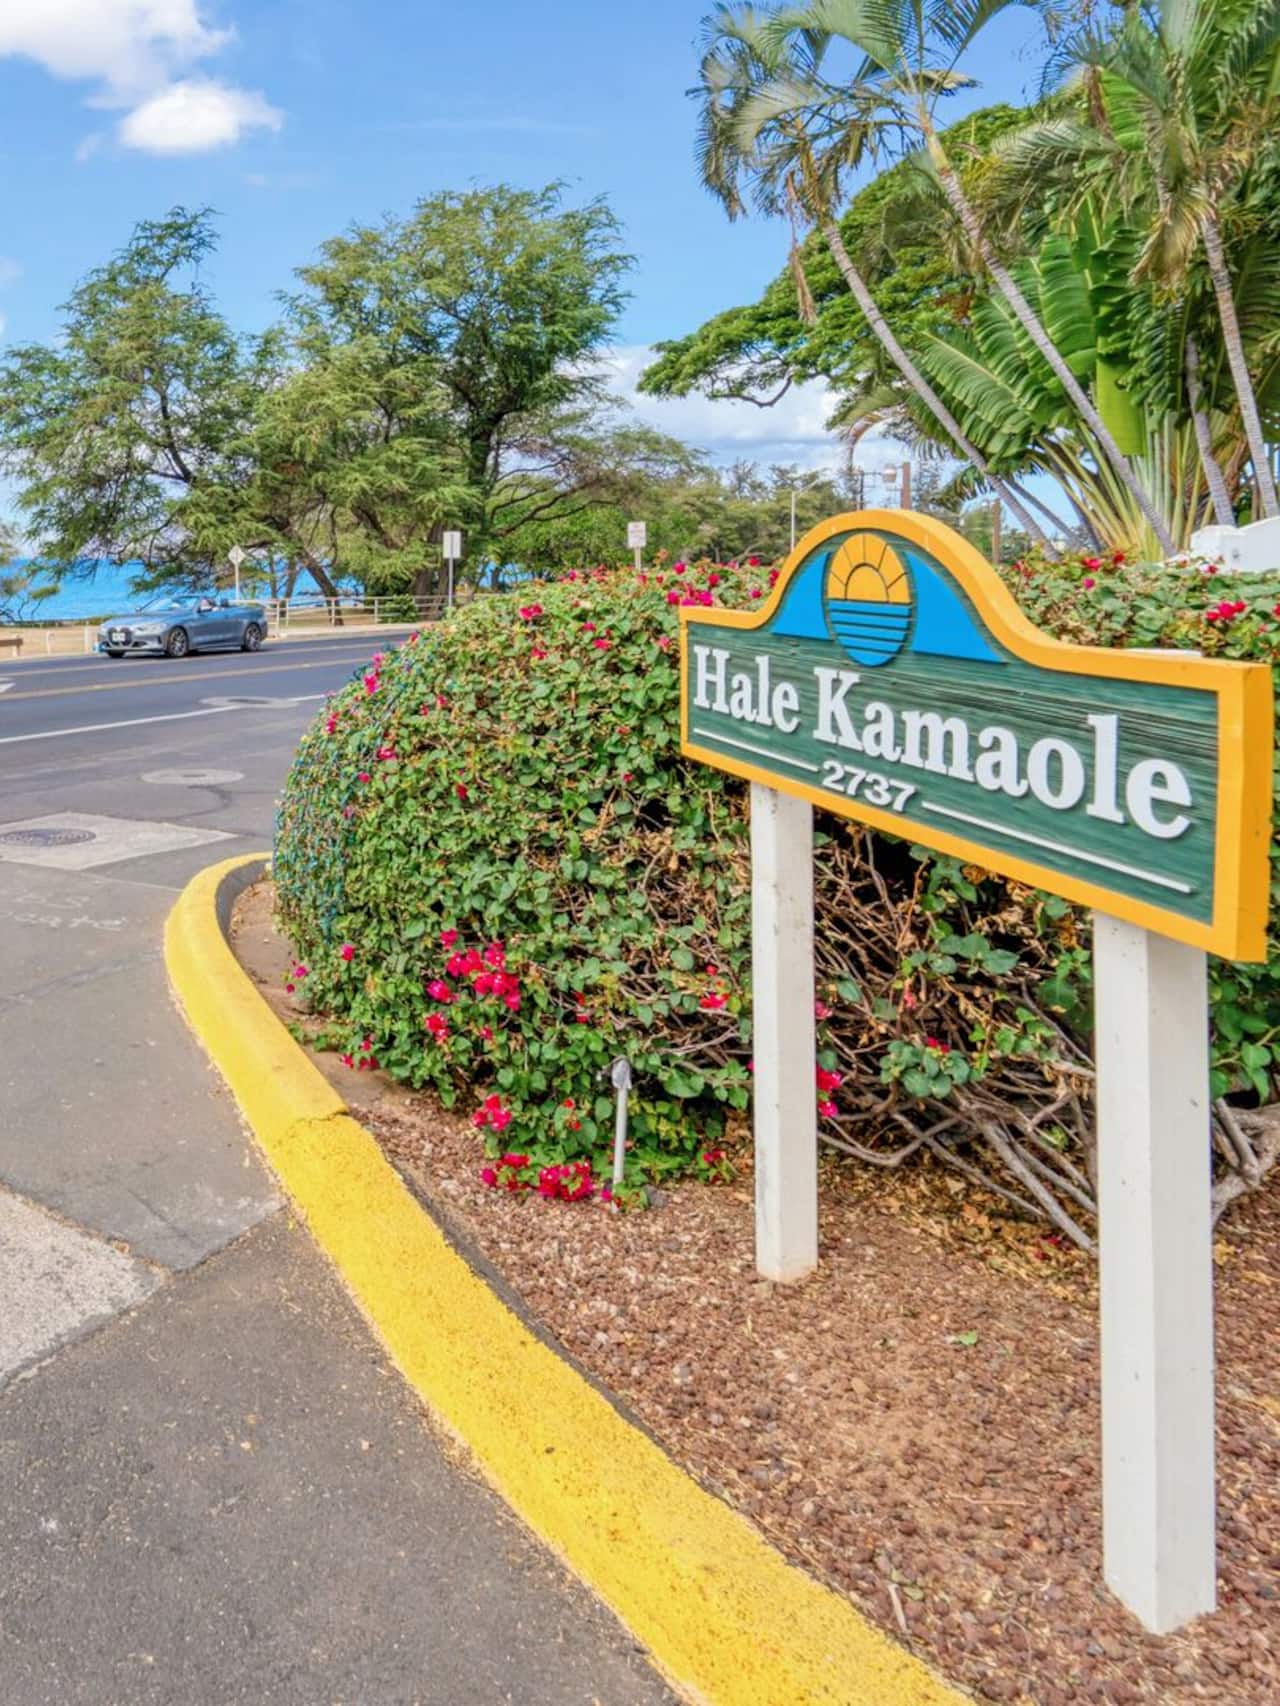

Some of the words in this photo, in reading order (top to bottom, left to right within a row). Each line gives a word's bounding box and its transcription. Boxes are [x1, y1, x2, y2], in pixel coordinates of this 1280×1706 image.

[693, 645, 800, 733] Hale
[814, 667, 1193, 838] Kamaole
[822, 760, 917, 813] 2737
